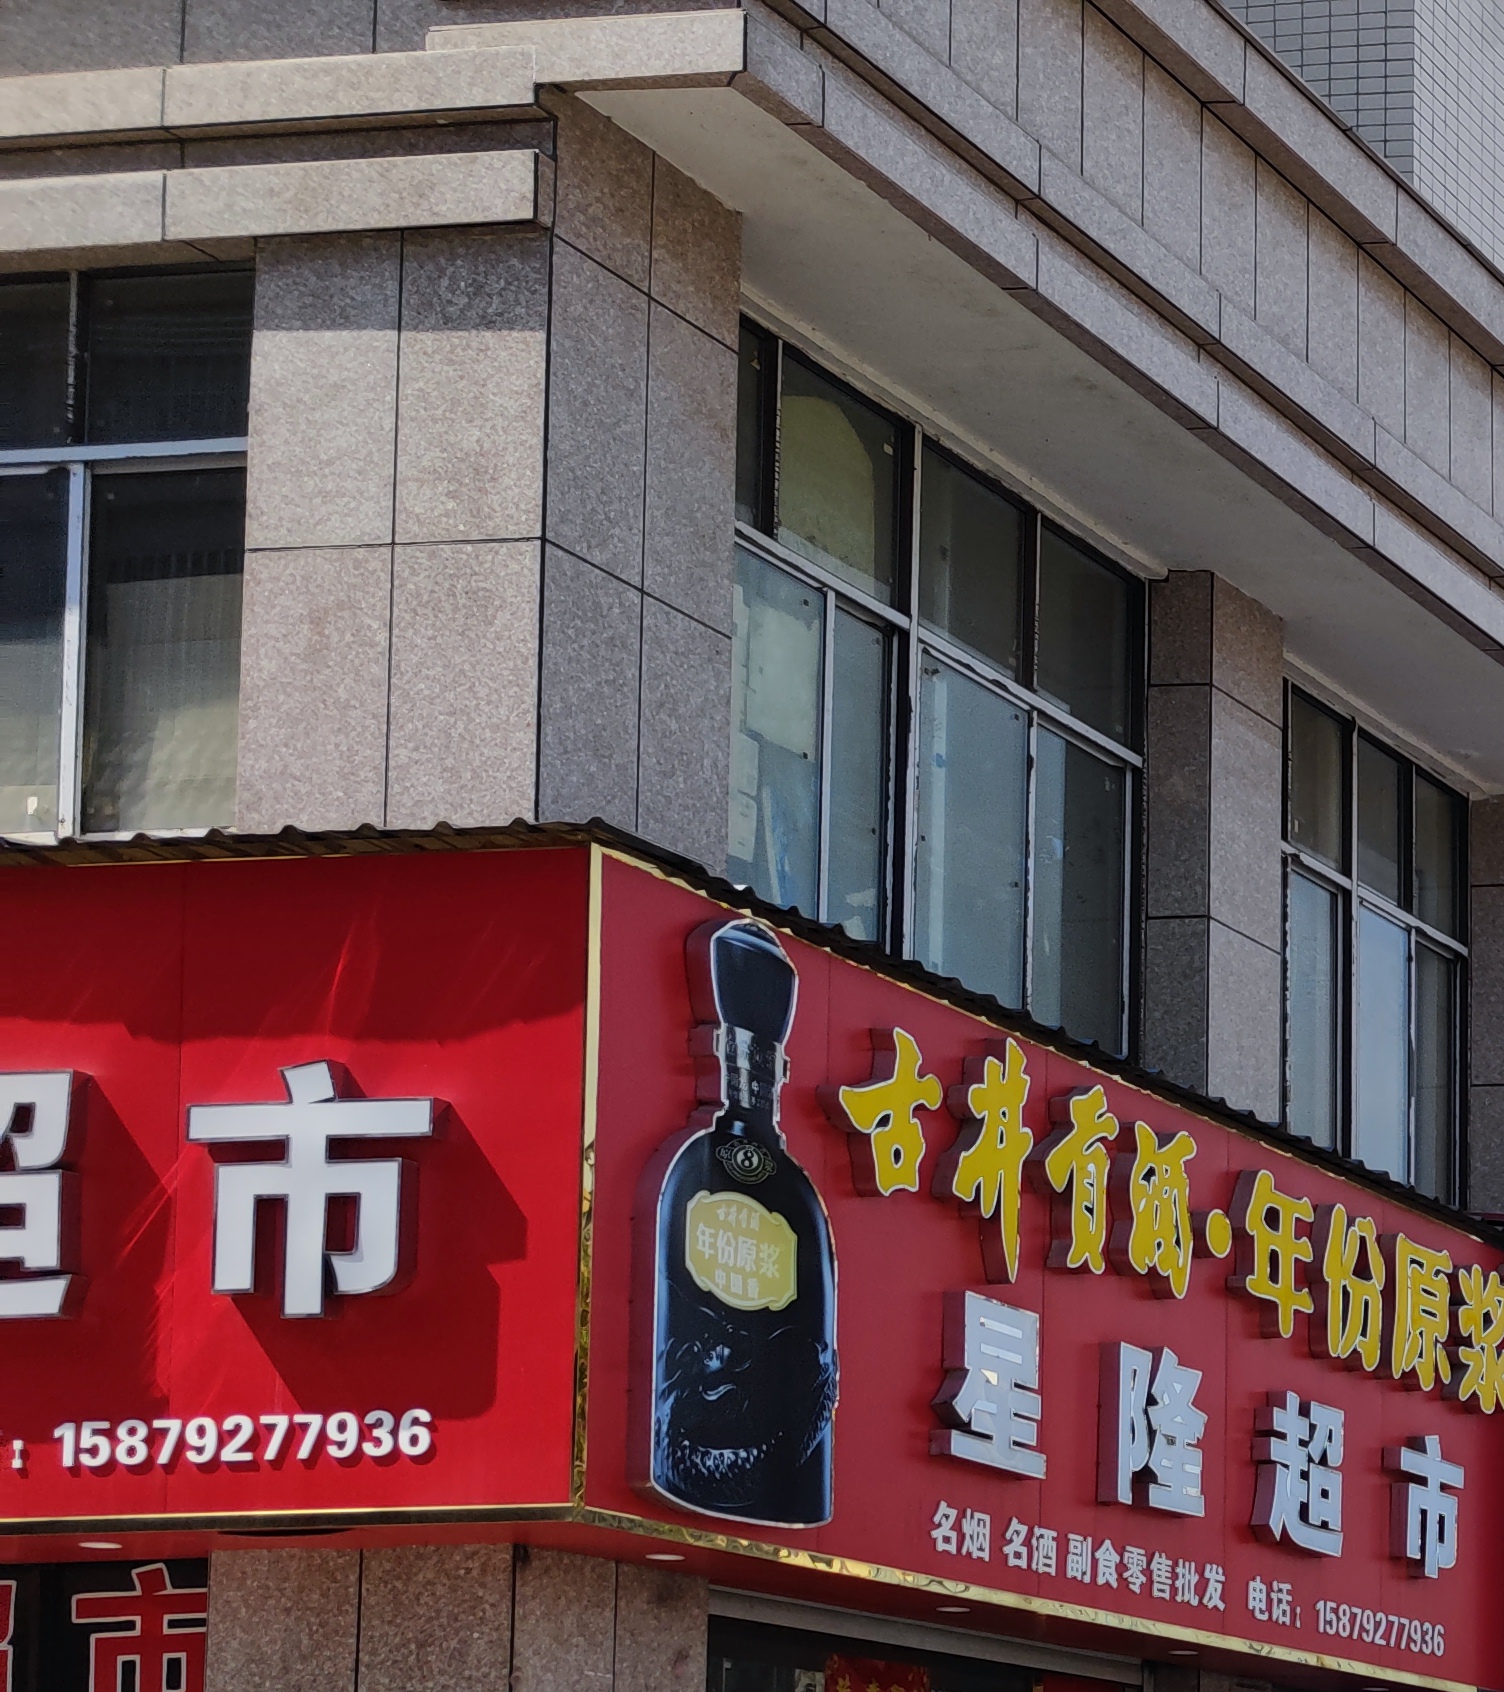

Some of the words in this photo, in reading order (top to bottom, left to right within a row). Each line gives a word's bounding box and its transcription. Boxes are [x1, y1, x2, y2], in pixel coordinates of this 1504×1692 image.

[696, 1222, 780, 1278] 年份原浆
[53, 1408, 432, 1469] 15879277936
[951, 1290, 1464, 1578] 星隆超市
[1316, 1600, 1444, 1656] 15879277936
